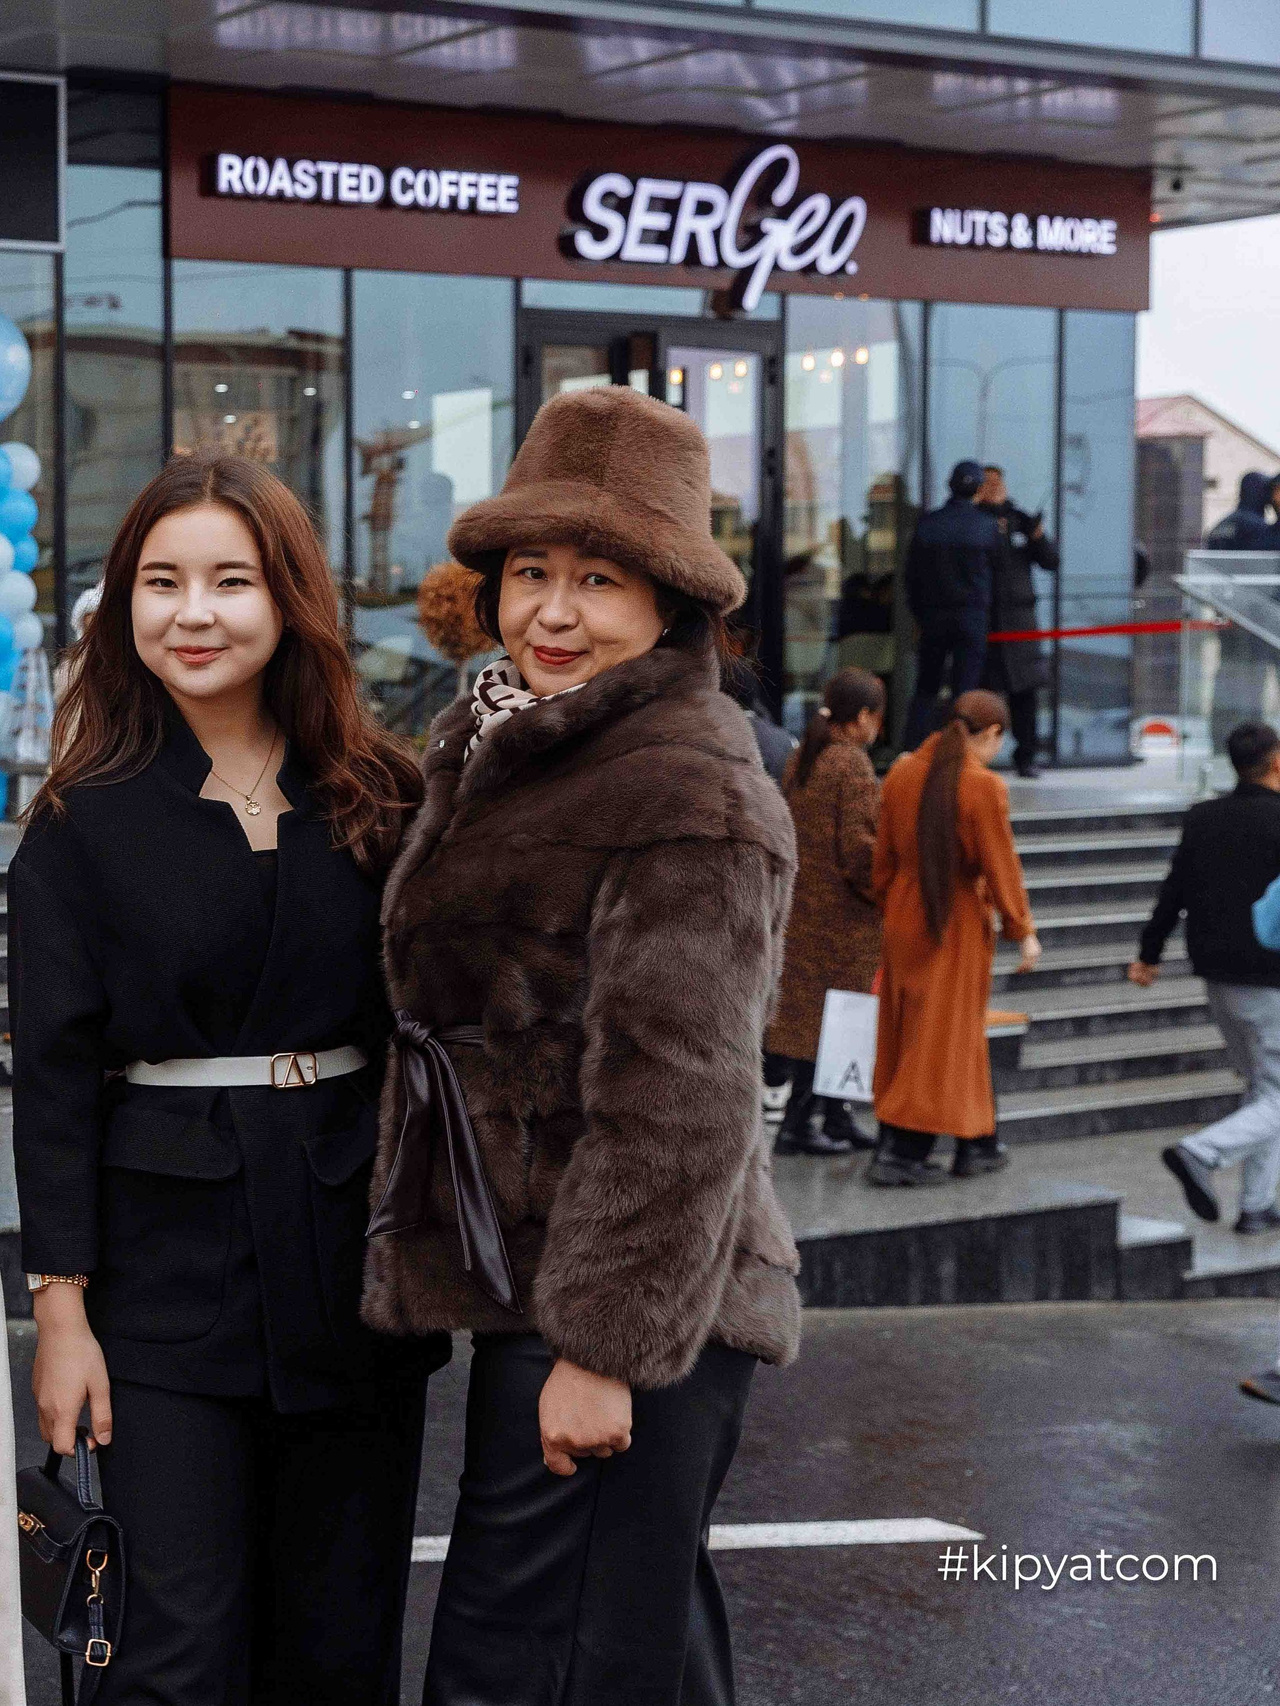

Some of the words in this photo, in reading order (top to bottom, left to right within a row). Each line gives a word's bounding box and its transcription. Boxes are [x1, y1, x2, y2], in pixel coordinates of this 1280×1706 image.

[217, 153, 384, 203] ROASTED
[390, 167, 519, 213] COFFEE
[930, 208, 1008, 248] NUTS
[1010, 214, 1033, 249] &
[1036, 215, 1119, 255] MORE
